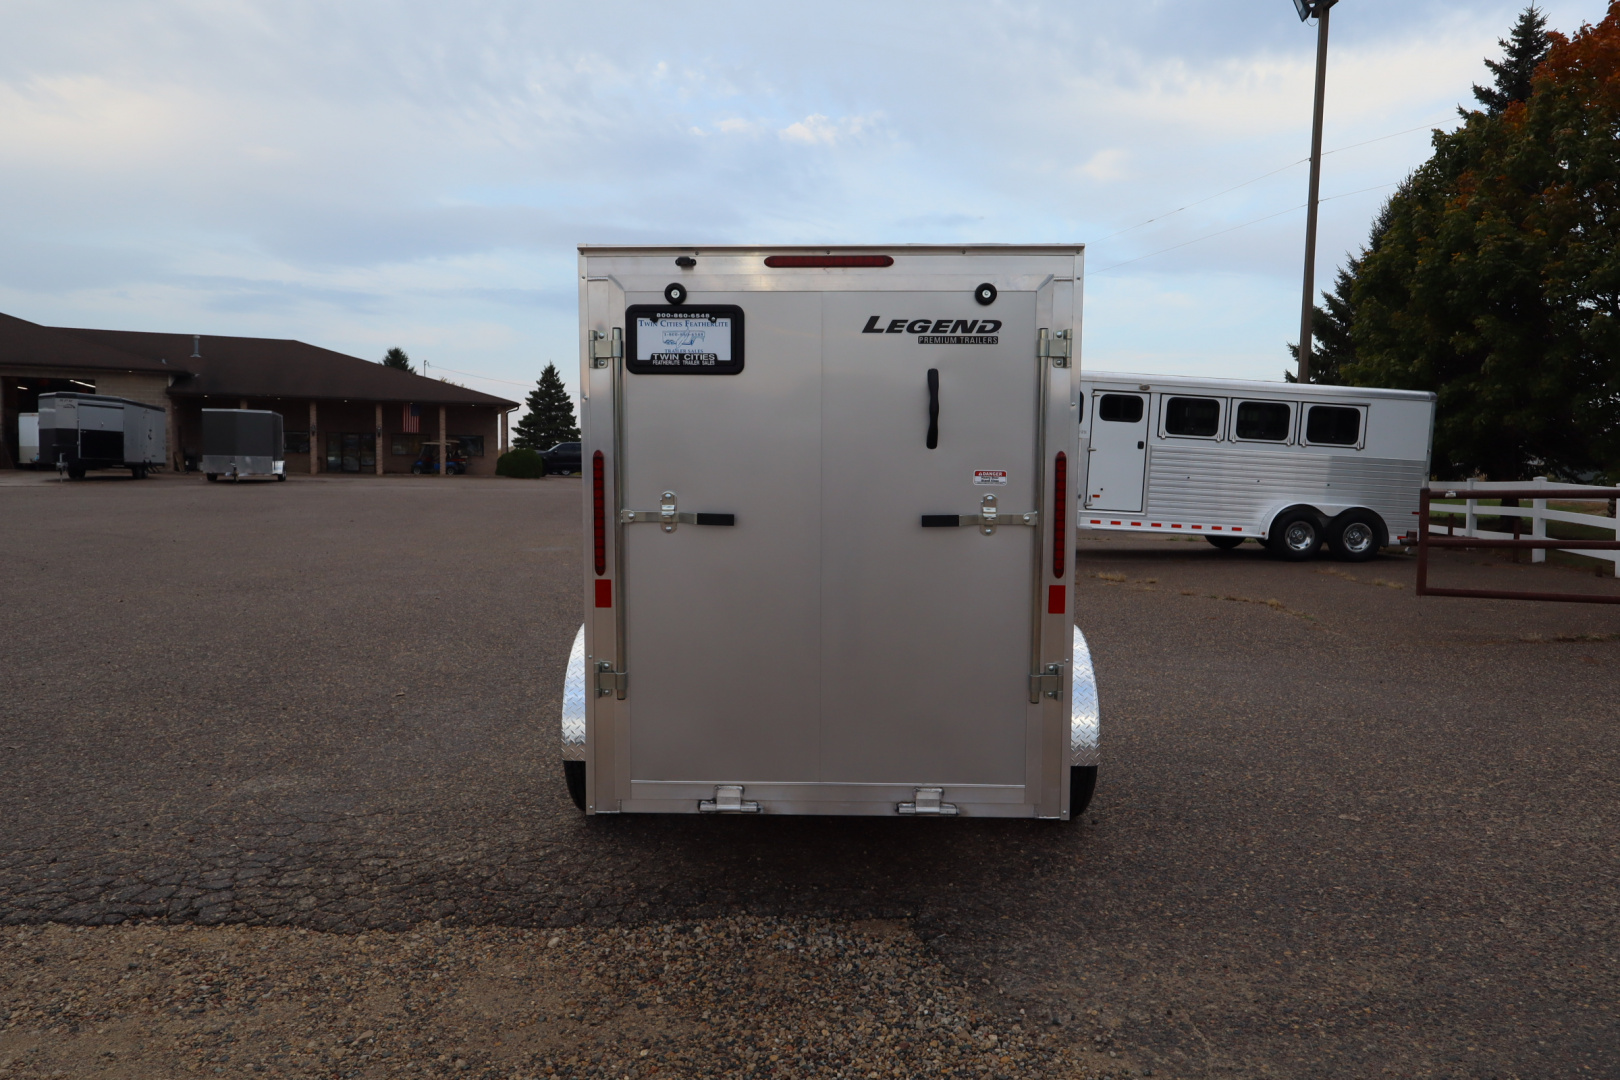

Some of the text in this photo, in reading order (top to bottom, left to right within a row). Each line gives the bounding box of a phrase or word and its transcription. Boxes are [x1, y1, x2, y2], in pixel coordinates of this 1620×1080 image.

[862, 315, 1003, 334] LEGEND
[918, 336, 998, 344] PREMIUM TRAILERS
